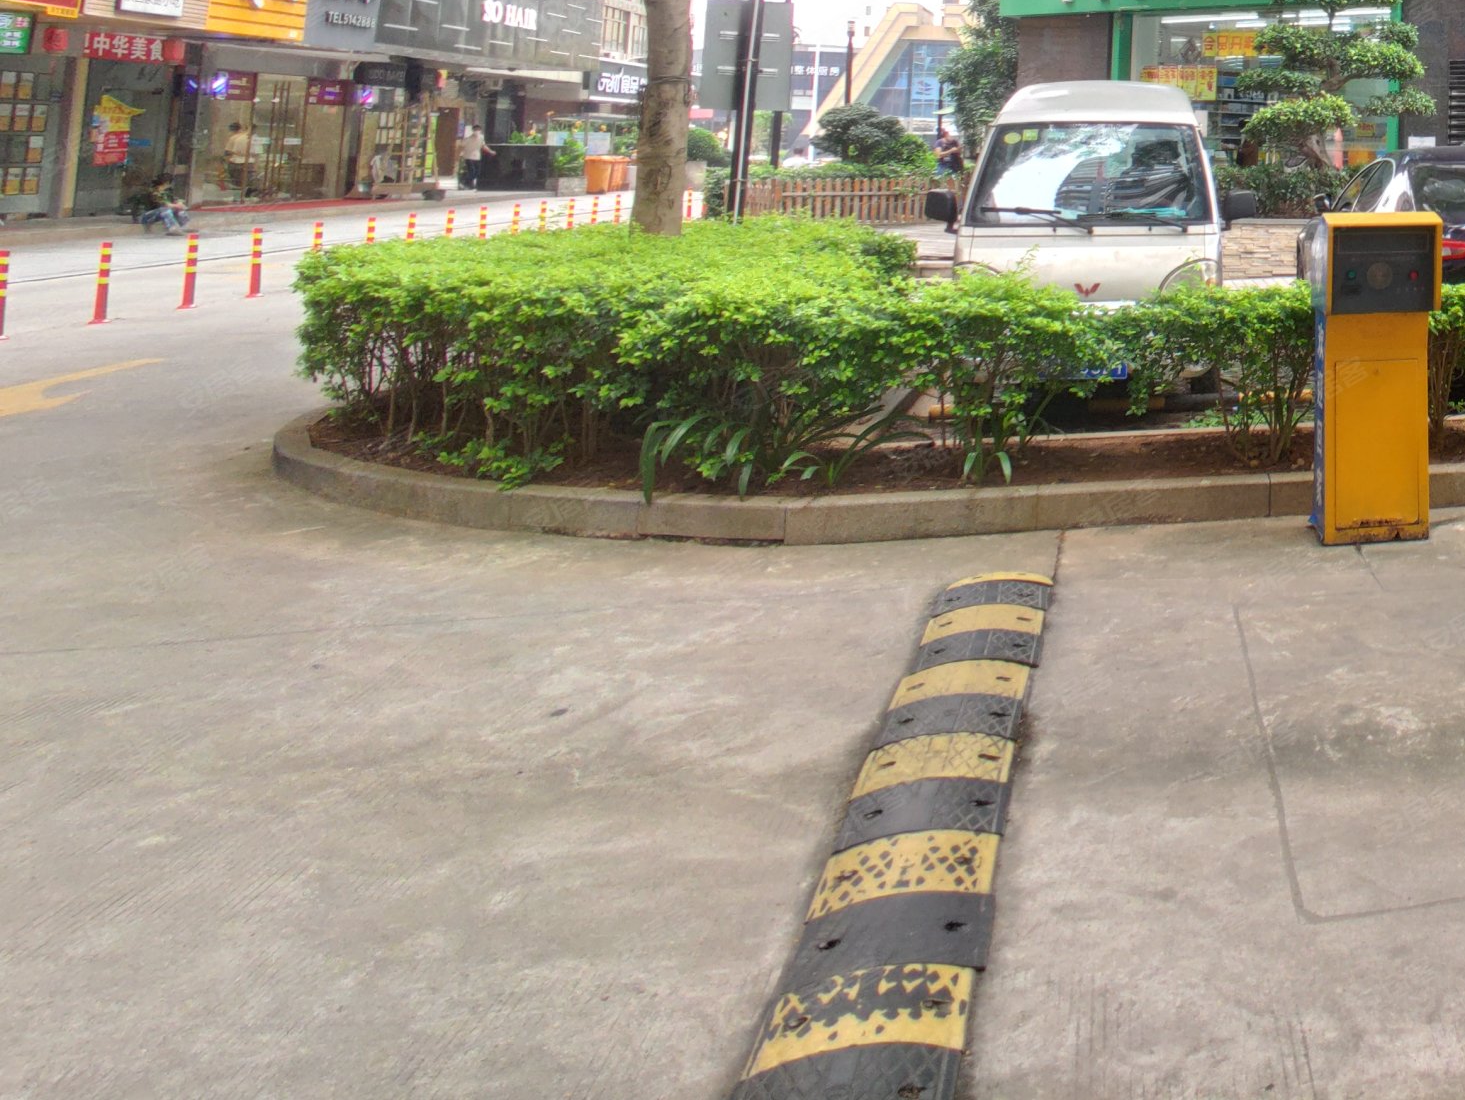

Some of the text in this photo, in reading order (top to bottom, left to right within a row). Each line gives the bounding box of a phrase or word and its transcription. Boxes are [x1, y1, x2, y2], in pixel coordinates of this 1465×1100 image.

[483, 0, 537, 30] SO HAIR
[791, 65, 841, 77] 整体厨房
